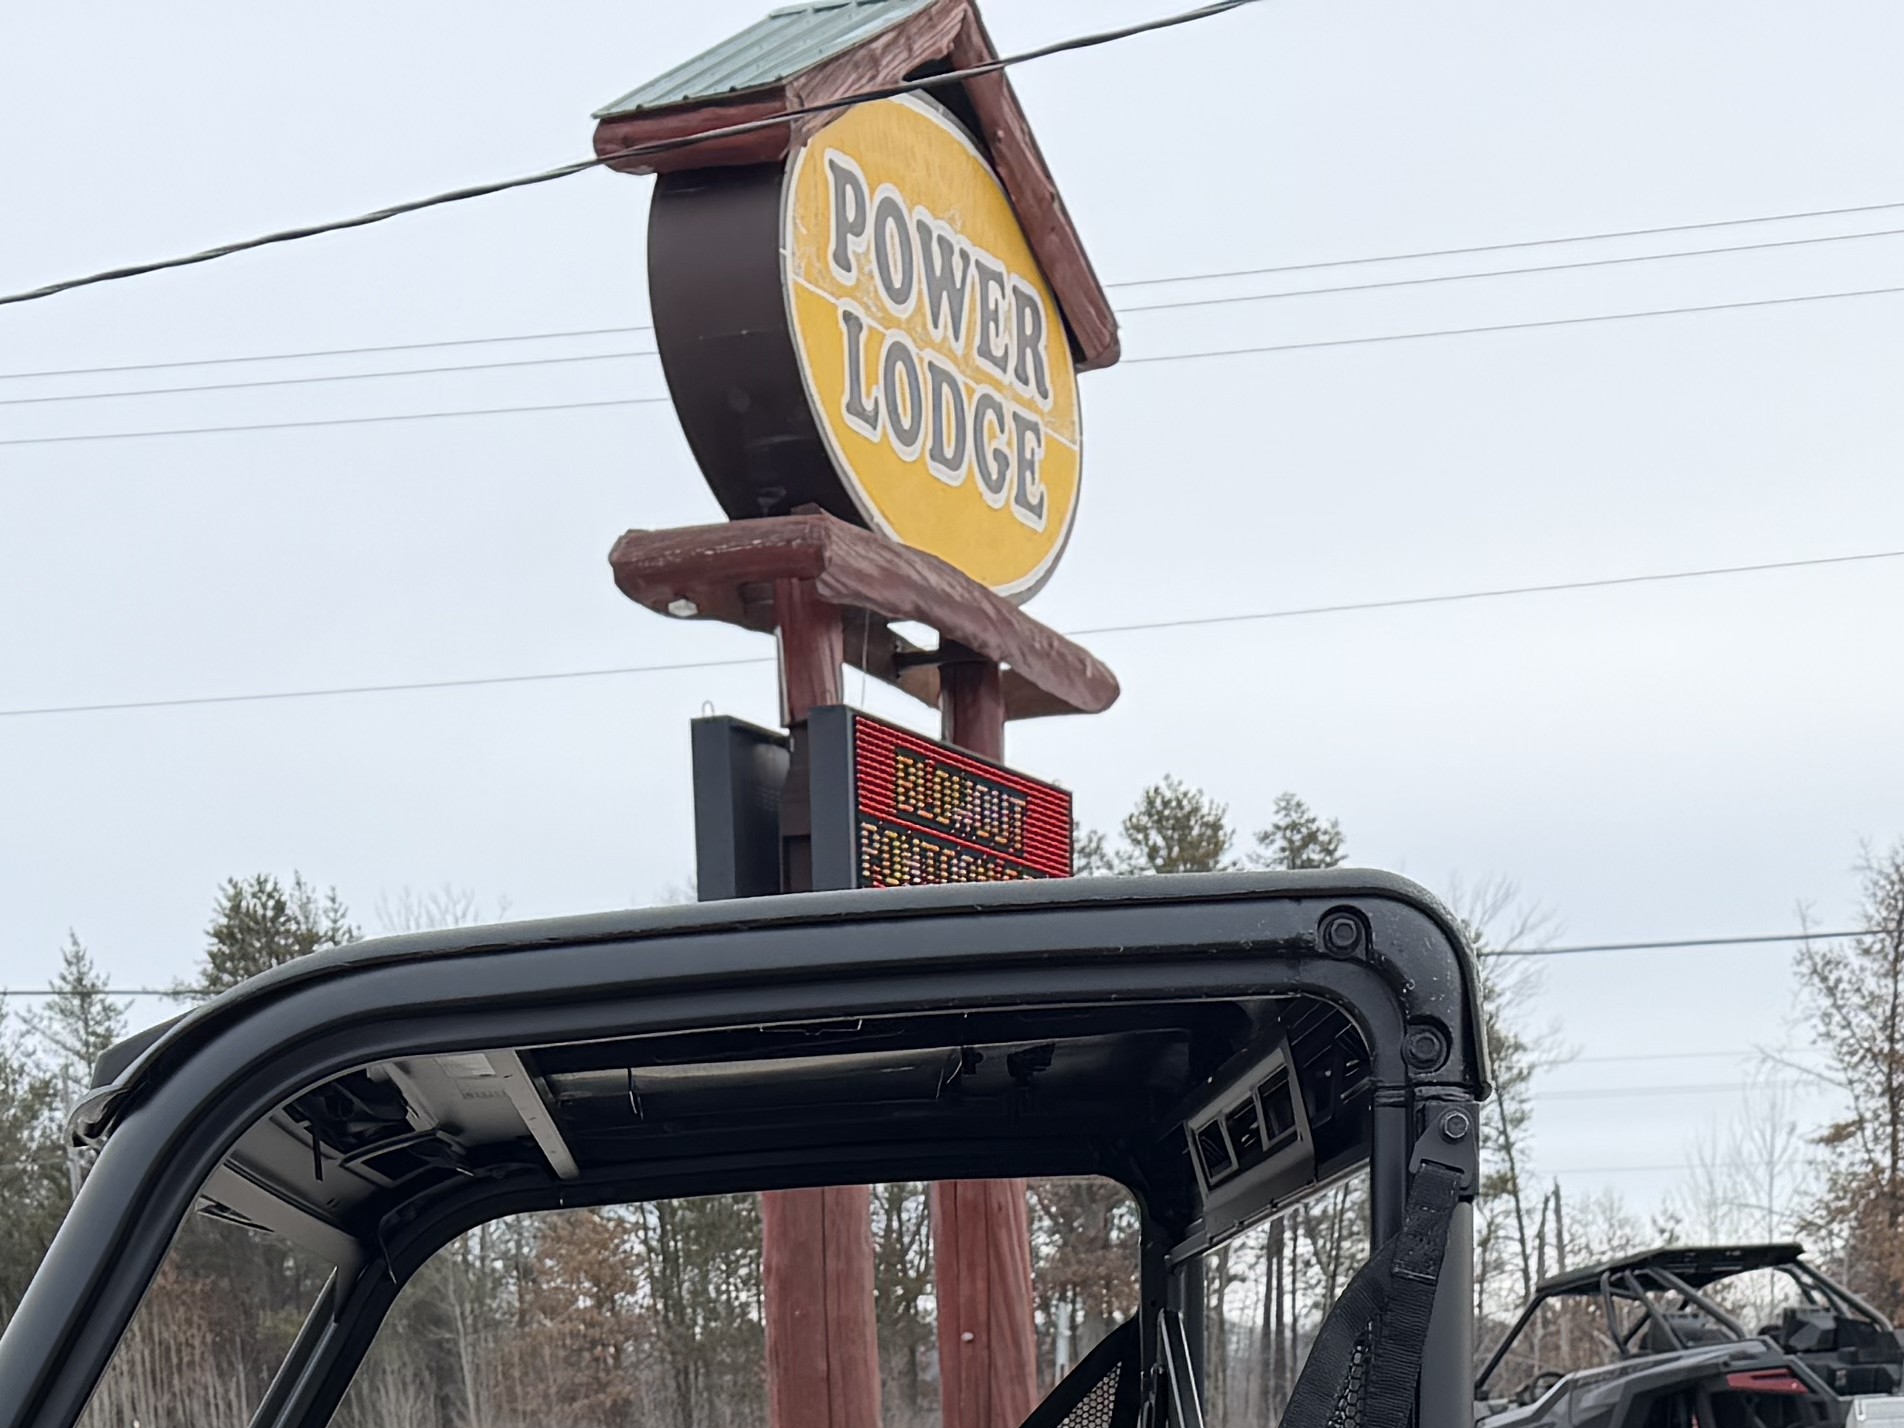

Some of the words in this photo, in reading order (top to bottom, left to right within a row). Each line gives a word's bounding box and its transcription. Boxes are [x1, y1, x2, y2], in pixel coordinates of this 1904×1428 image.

[828, 157, 1051, 402] POWER
[841, 309, 1046, 523] LODGE
[896, 753, 1027, 852] BLOWOUT
